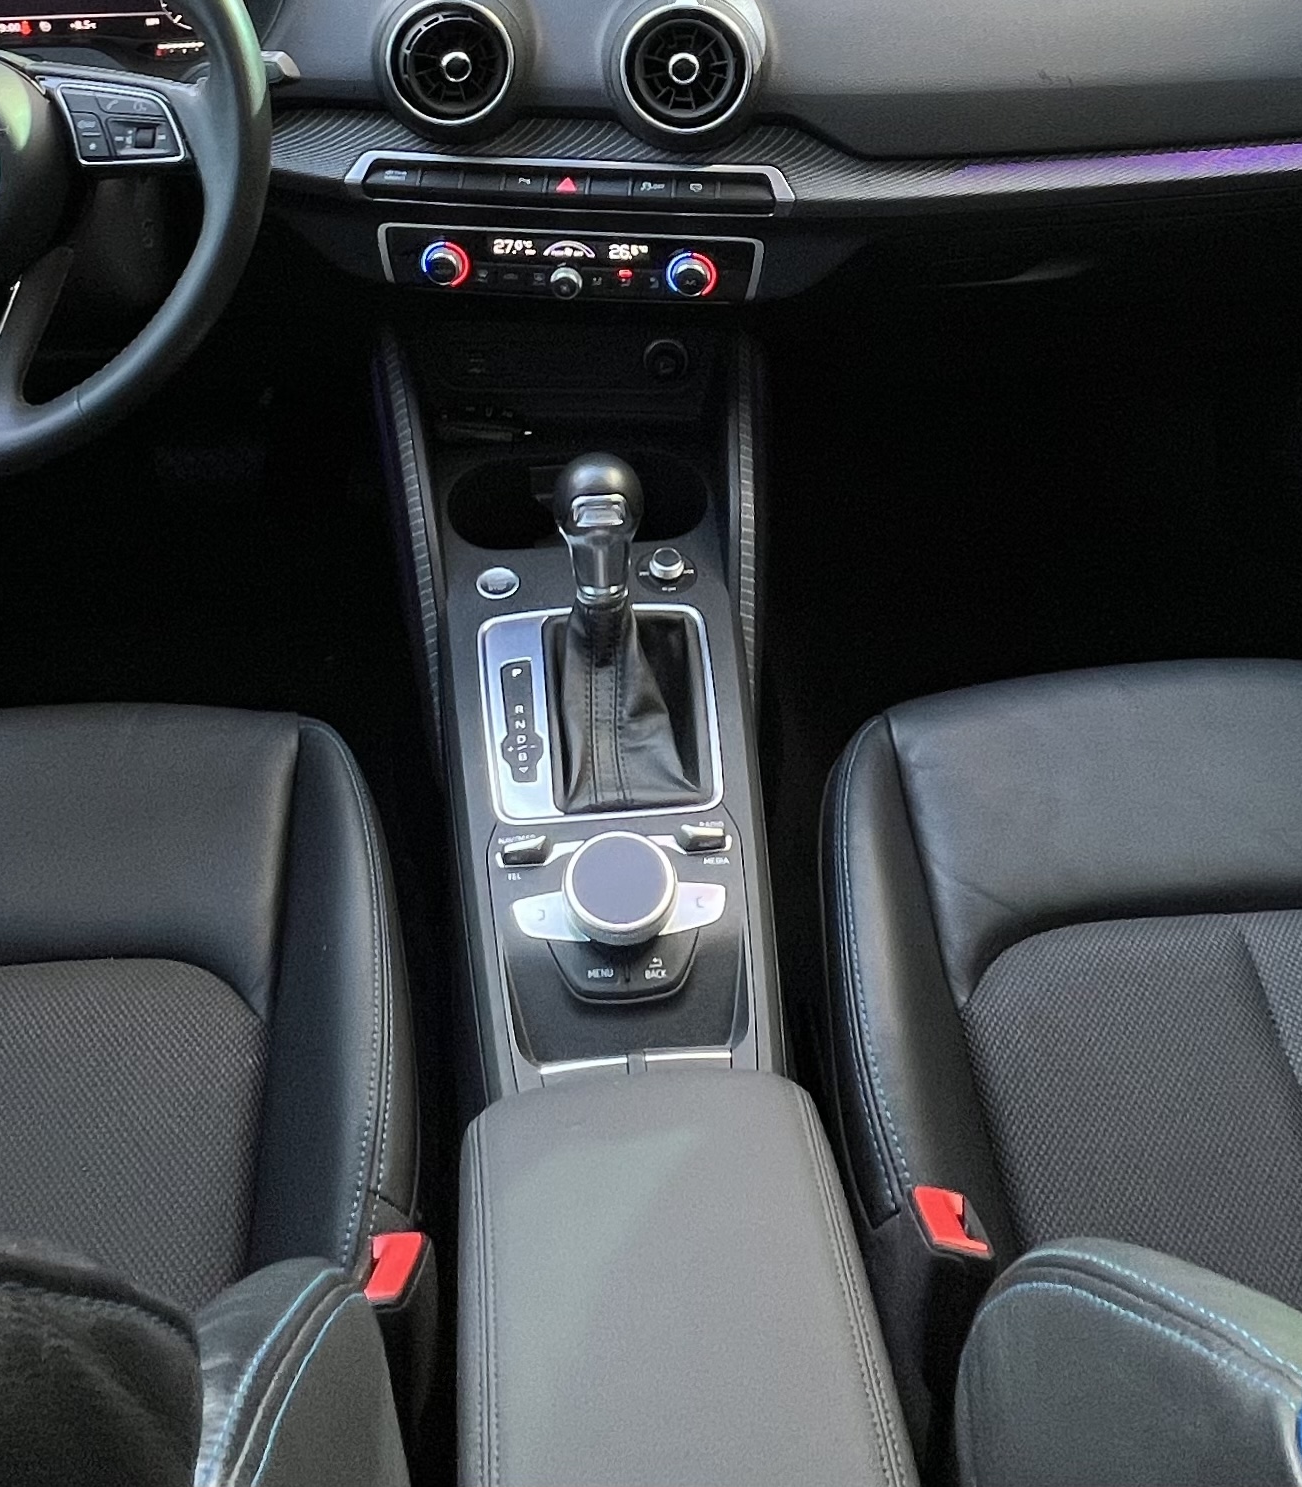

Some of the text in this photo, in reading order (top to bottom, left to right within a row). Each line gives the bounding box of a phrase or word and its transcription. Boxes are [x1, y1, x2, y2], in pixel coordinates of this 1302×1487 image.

[511, 668, 522, 678] P
[514, 704, 525, 714] R
[515, 719, 526, 729] N
[516, 734, 527, 744] D
[703, 856, 730, 865] MEDIA
[587, 968, 614, 979] MENU
[644, 968, 667, 980] BACK
